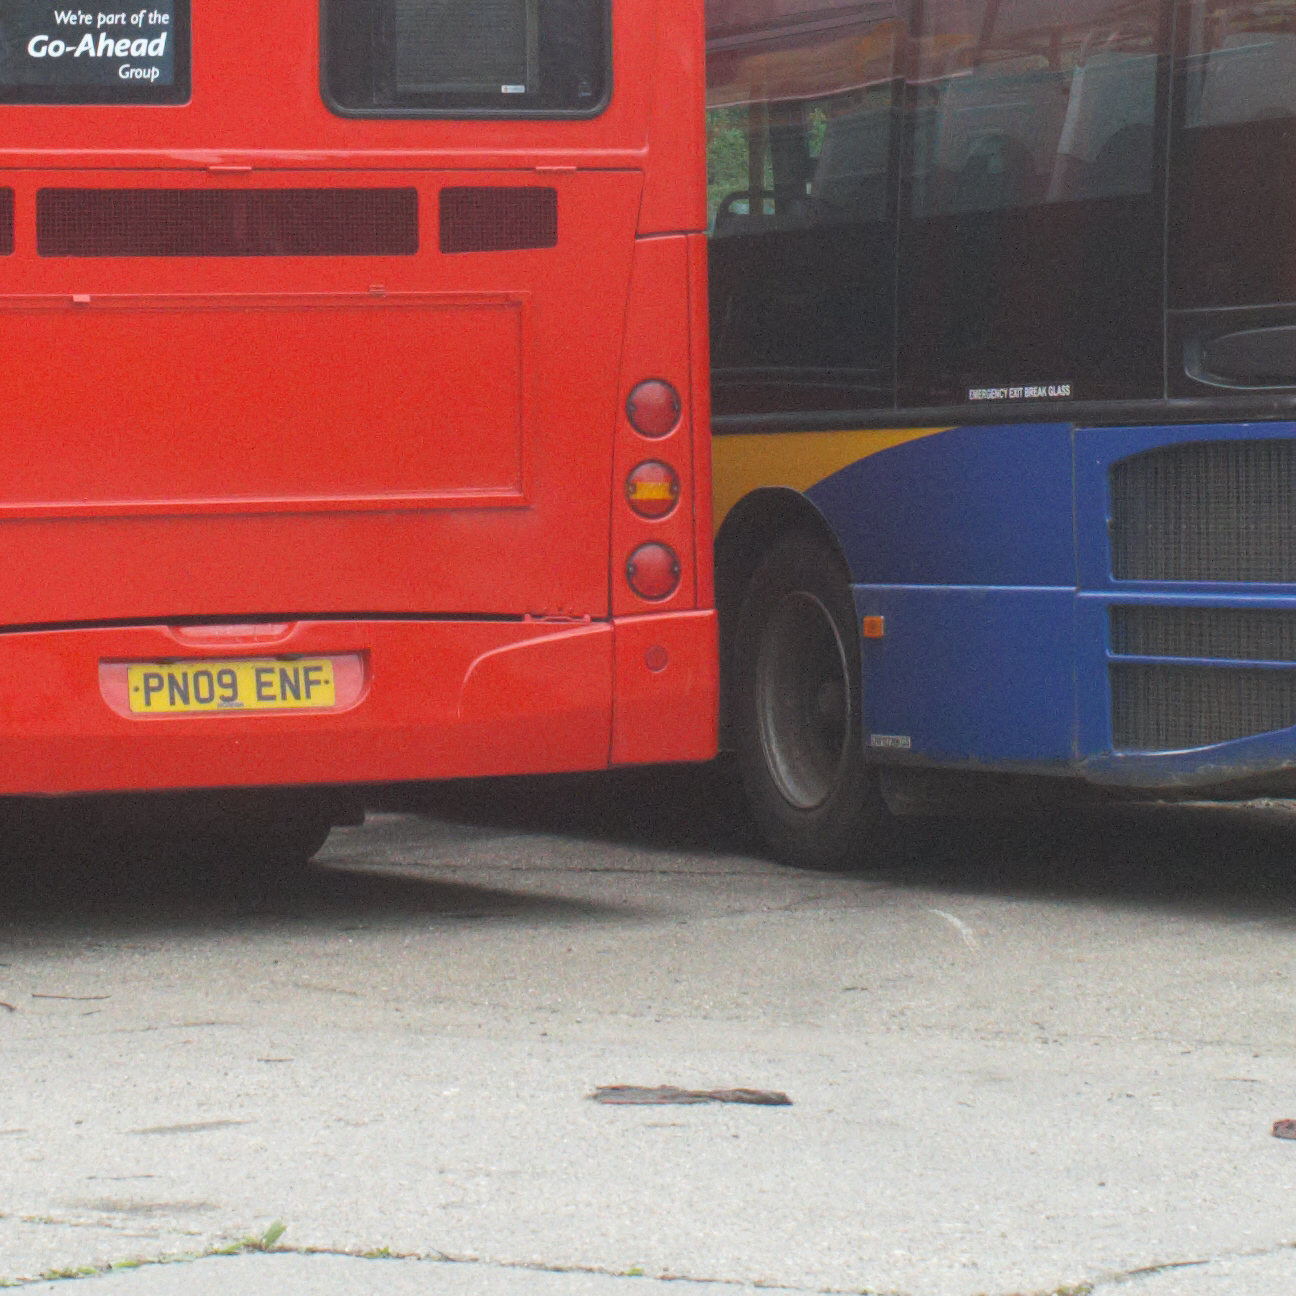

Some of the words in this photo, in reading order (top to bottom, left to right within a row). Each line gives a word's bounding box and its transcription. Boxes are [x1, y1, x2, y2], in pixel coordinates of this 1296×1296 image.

[54, 10, 93, 25] We're
[97, 11, 127, 29] part
[131, 9, 146, 28] of
[149, 10, 170, 25] the
[27, 32, 168, 58] Go-Ahead
[118, 64, 160, 83] Group
[969, 387, 1007, 400] EMERGENCY
[1009, 386, 1023, 399] EXIT
[1025, 386, 1047, 398] BREAK
[1048, 384, 1070, 397] GLASS
[142, 668, 238, 707] PN09
[255, 665, 324, 702] ENF
